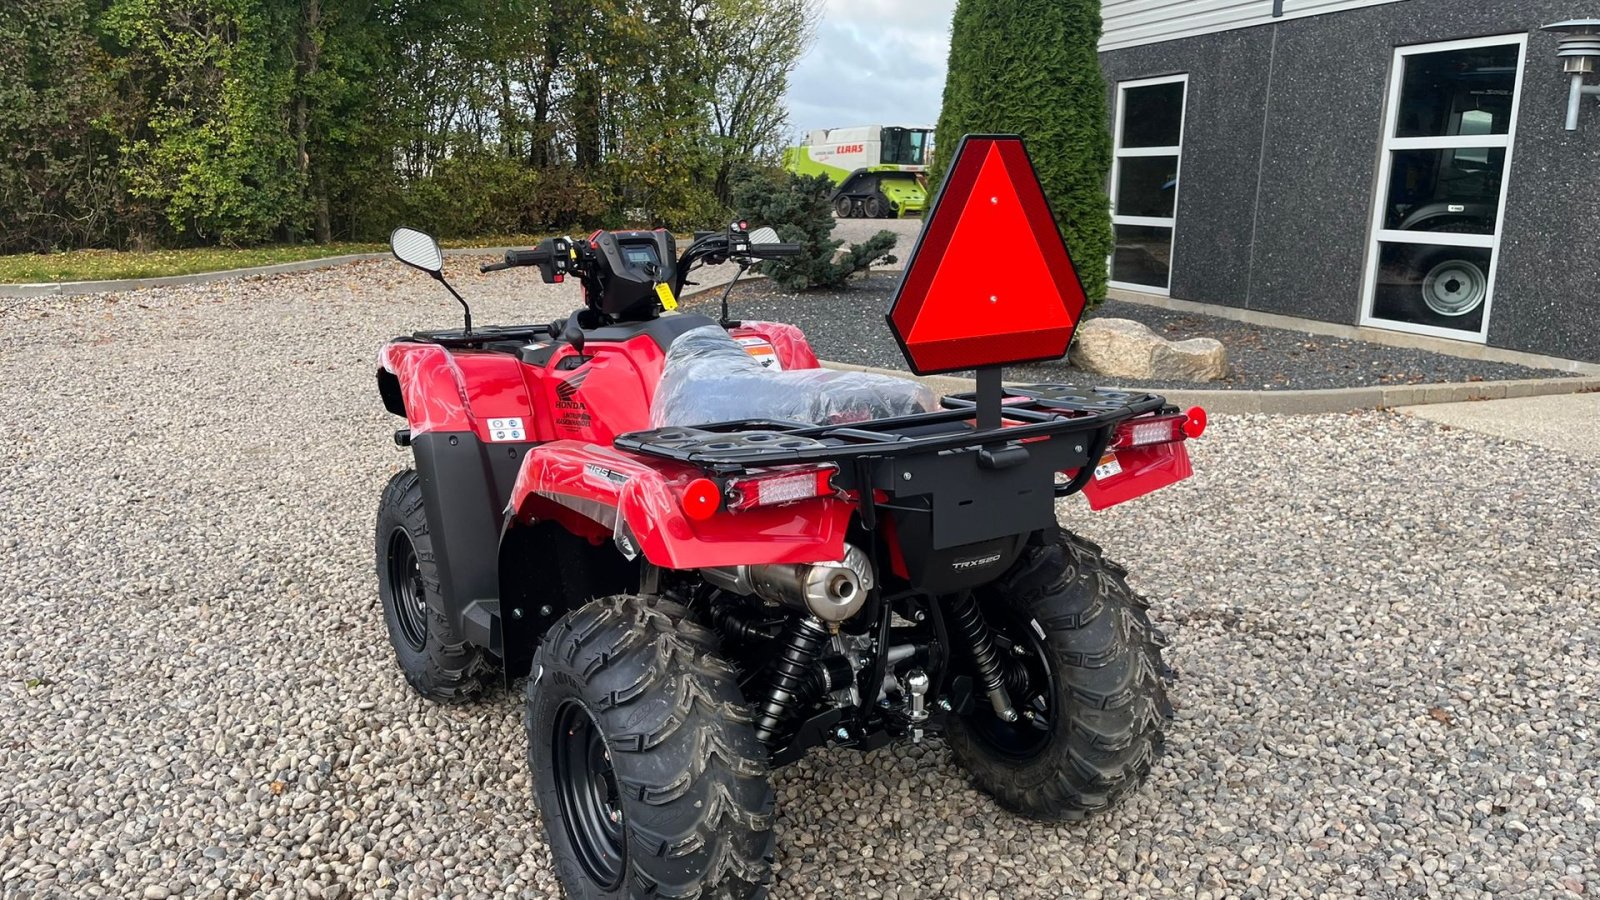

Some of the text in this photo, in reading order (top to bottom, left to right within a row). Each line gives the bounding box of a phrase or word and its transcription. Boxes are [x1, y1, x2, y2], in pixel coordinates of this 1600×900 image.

[836, 144, 863, 154] CLAAS
[556, 402, 586, 410] HONDA
[590, 464, 609, 476] IRS
[952, 554, 1001, 569] TRX520
